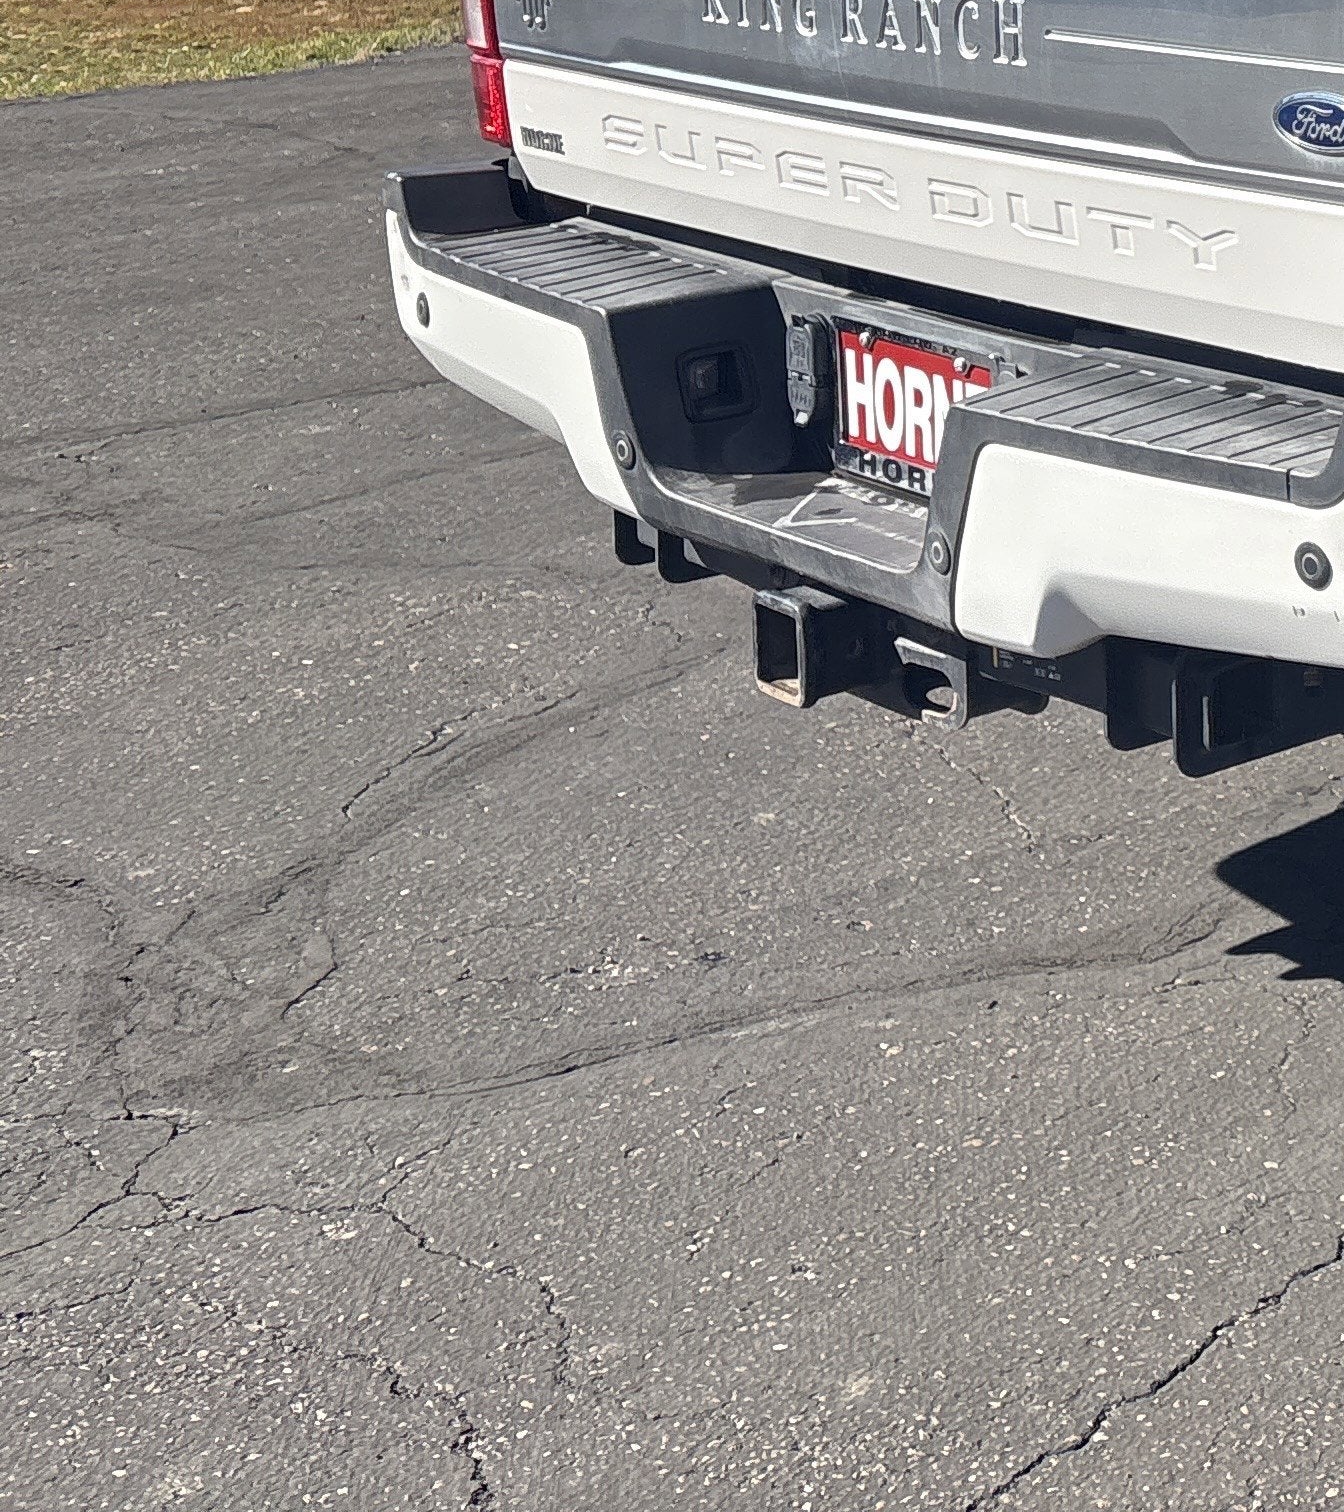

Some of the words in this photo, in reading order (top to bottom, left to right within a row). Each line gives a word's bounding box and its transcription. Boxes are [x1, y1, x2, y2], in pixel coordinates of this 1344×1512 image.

[601, 113, 901, 211] SUPER
[926, 176, 1240, 271] DUTY
[844, 347, 991, 465] HORN
[857, 453, 927, 492] HOR
